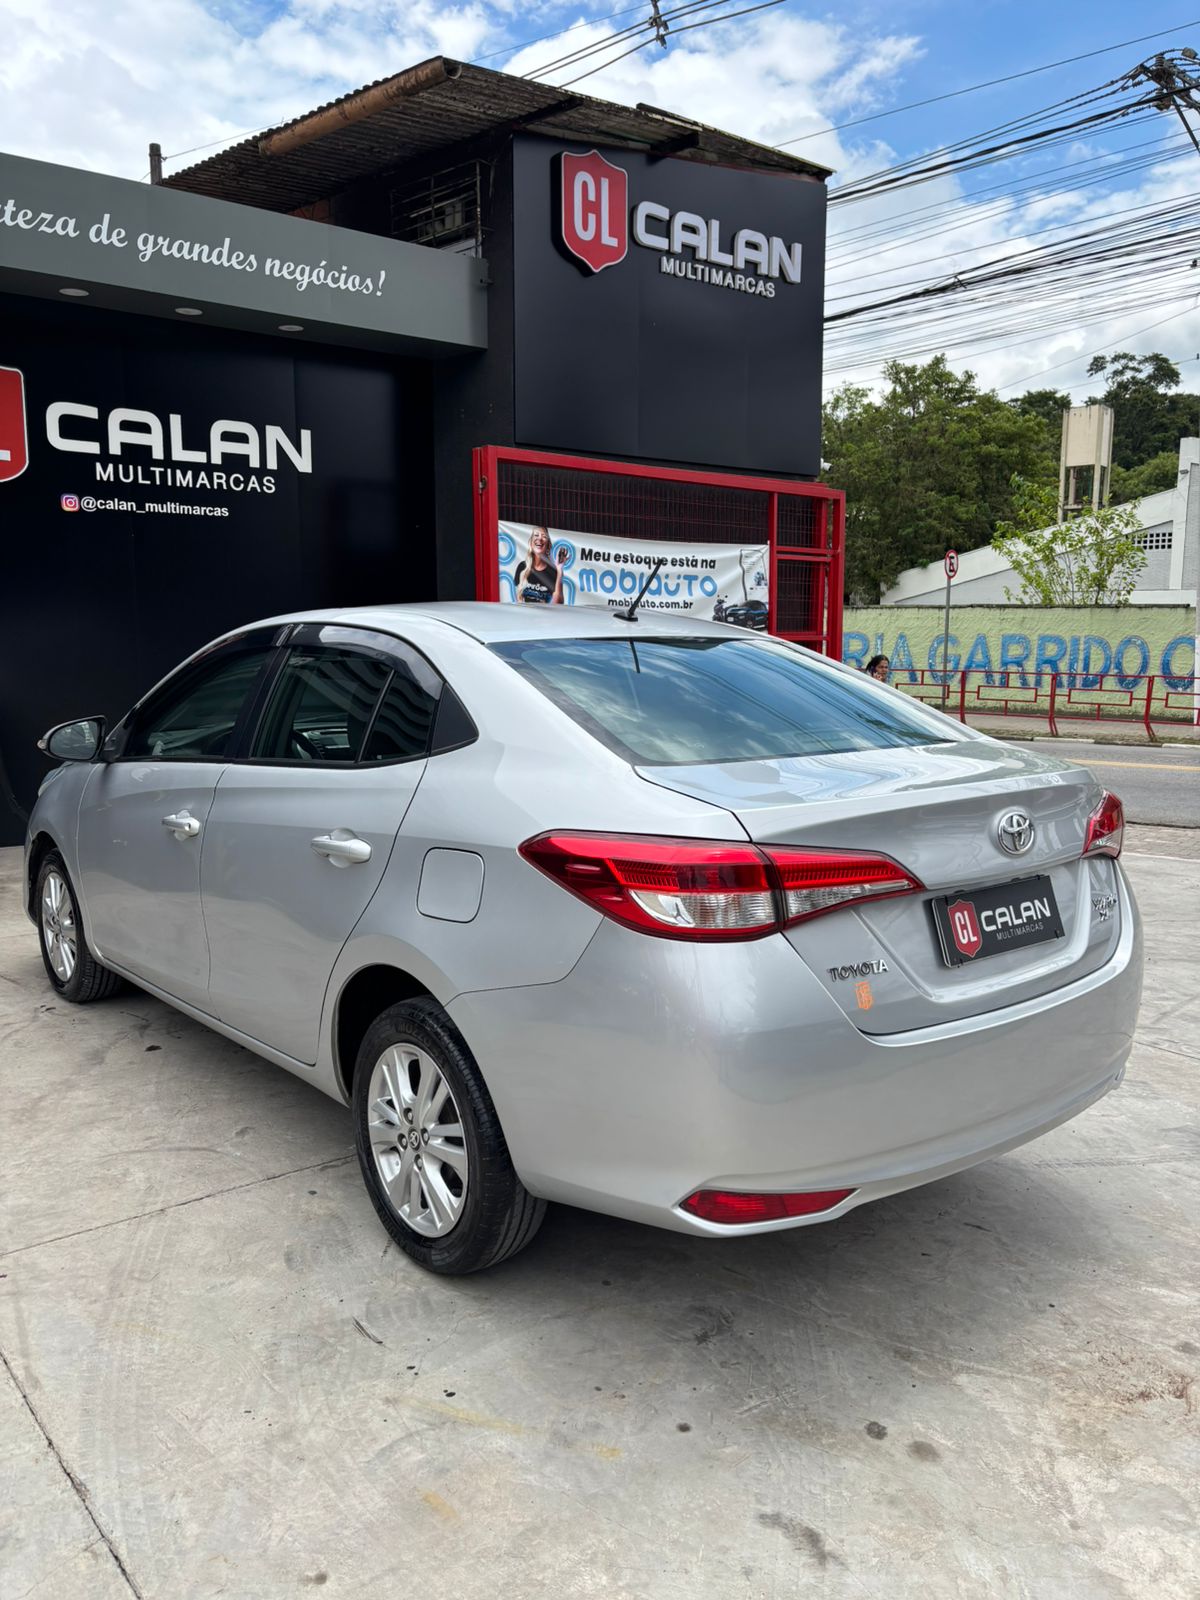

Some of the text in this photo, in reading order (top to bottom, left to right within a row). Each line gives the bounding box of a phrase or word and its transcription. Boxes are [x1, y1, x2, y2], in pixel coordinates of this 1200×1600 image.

[573, 171, 618, 248] CL
[0, 199, 386, 297] teza de grandes negócios!
[633, 200, 802, 284] CALAN
[660, 255, 776, 298] MULTIMARCAS
[46, 401, 313, 474] CALAN
[95, 461, 277, 494] MULTIMARCAS
[80, 496, 230, 517] @calan_multimarcas
[580, 547, 717, 570] Meu estoque está na
[927, 632, 1150, 690] GARRIDO
[955, 910, 978, 945] CL
[981, 897, 1052, 932] CALAN
[996, 922, 1044, 940] MULTIMARCAS
[827, 959, 890, 983] TOYOTA
